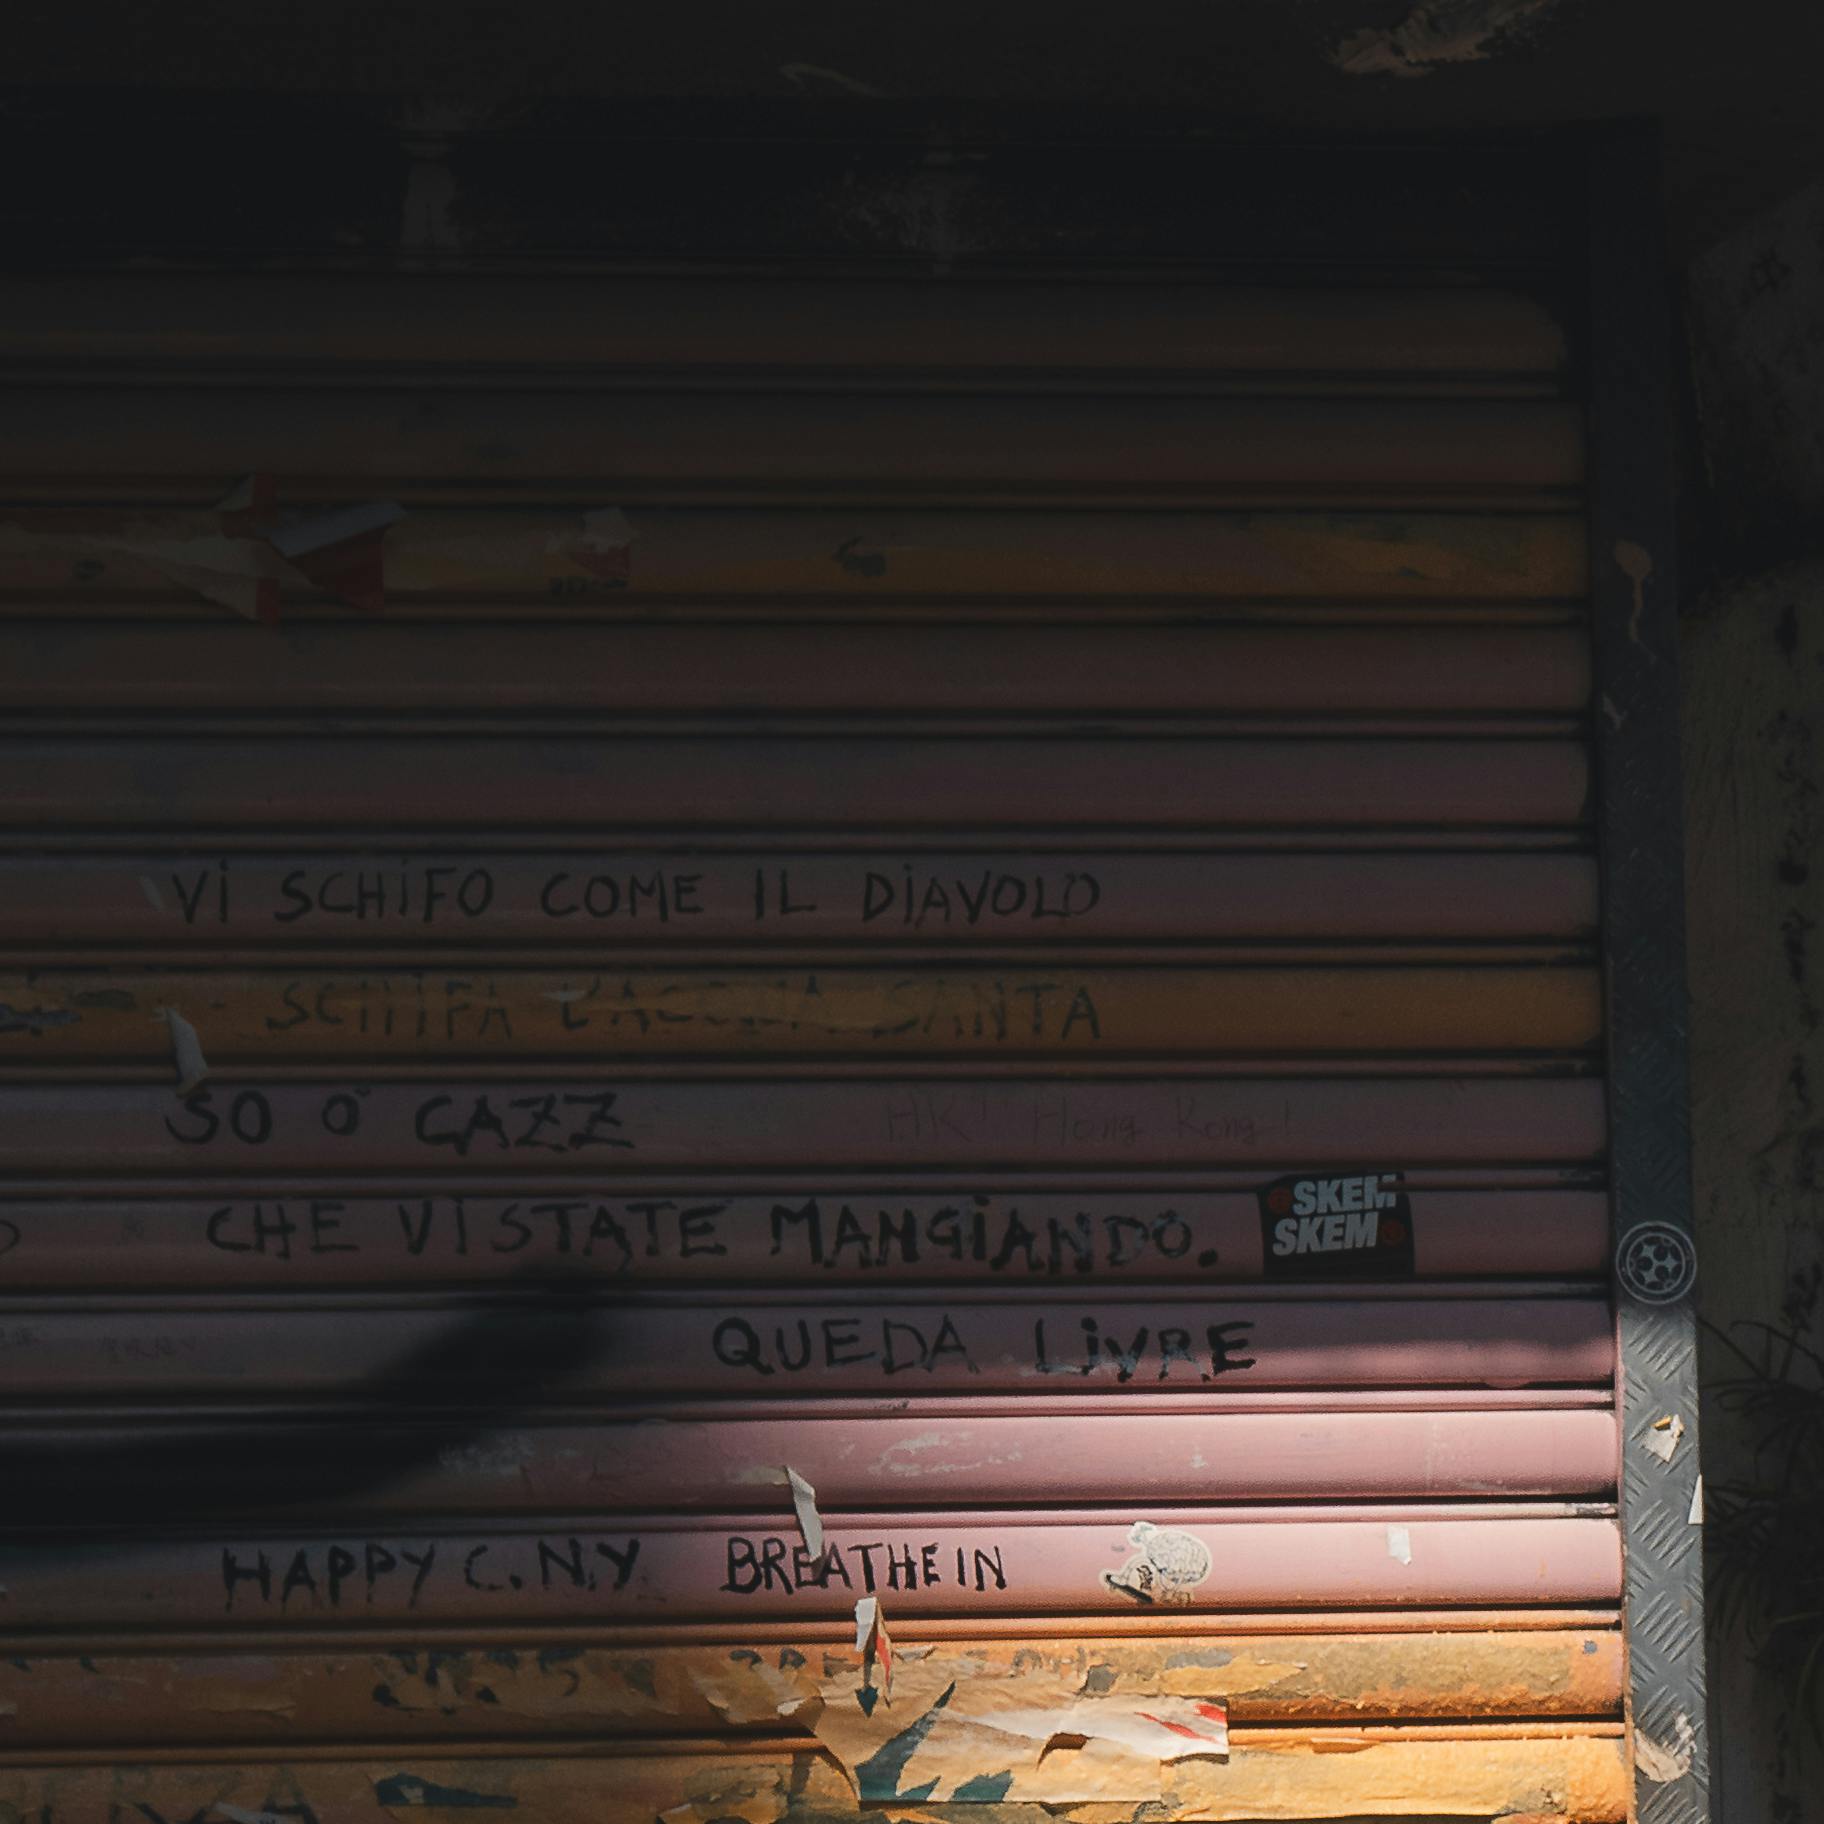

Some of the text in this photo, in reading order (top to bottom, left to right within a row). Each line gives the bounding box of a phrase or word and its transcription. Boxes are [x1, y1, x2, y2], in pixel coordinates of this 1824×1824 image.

[540, 868, 704, 924] COME
[755, 868, 817, 921] IL
[164, 1084, 273, 1145] SO
[413, 1092, 635, 1156] CAZZ
[204, 1200, 359, 1260] CHE
[1271, 1210, 1381, 1257] SKEM
[711, 1313, 981, 1376] QUEDA
[220, 1541, 437, 1614] HAPPY
